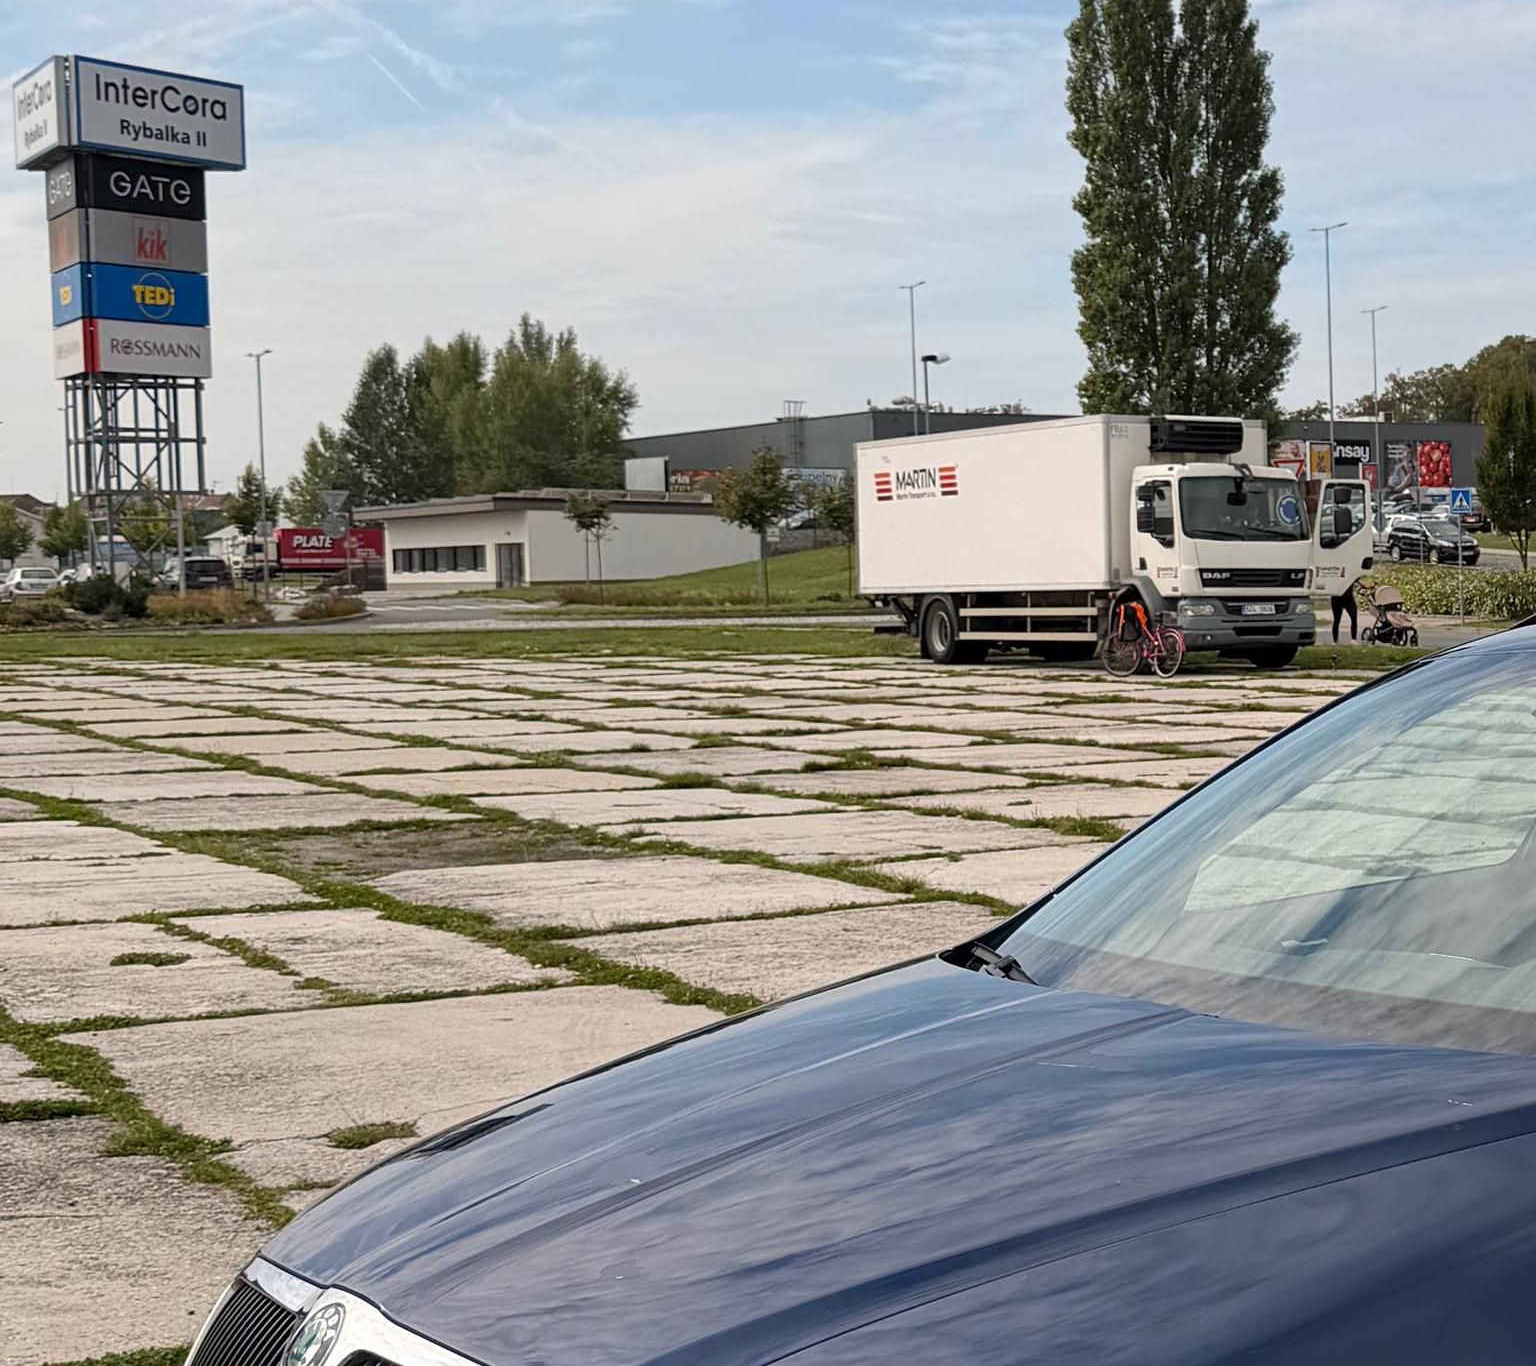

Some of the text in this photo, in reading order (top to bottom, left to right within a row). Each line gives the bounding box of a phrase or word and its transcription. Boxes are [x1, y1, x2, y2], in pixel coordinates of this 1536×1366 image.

[95, 73, 228, 121] InterCora
[119, 118, 207, 147] Rybalka II
[111, 338, 201, 359] ROSSMANN
[896, 467, 937, 491] MARTIN
[1202, 572, 1231, 580] DAF
